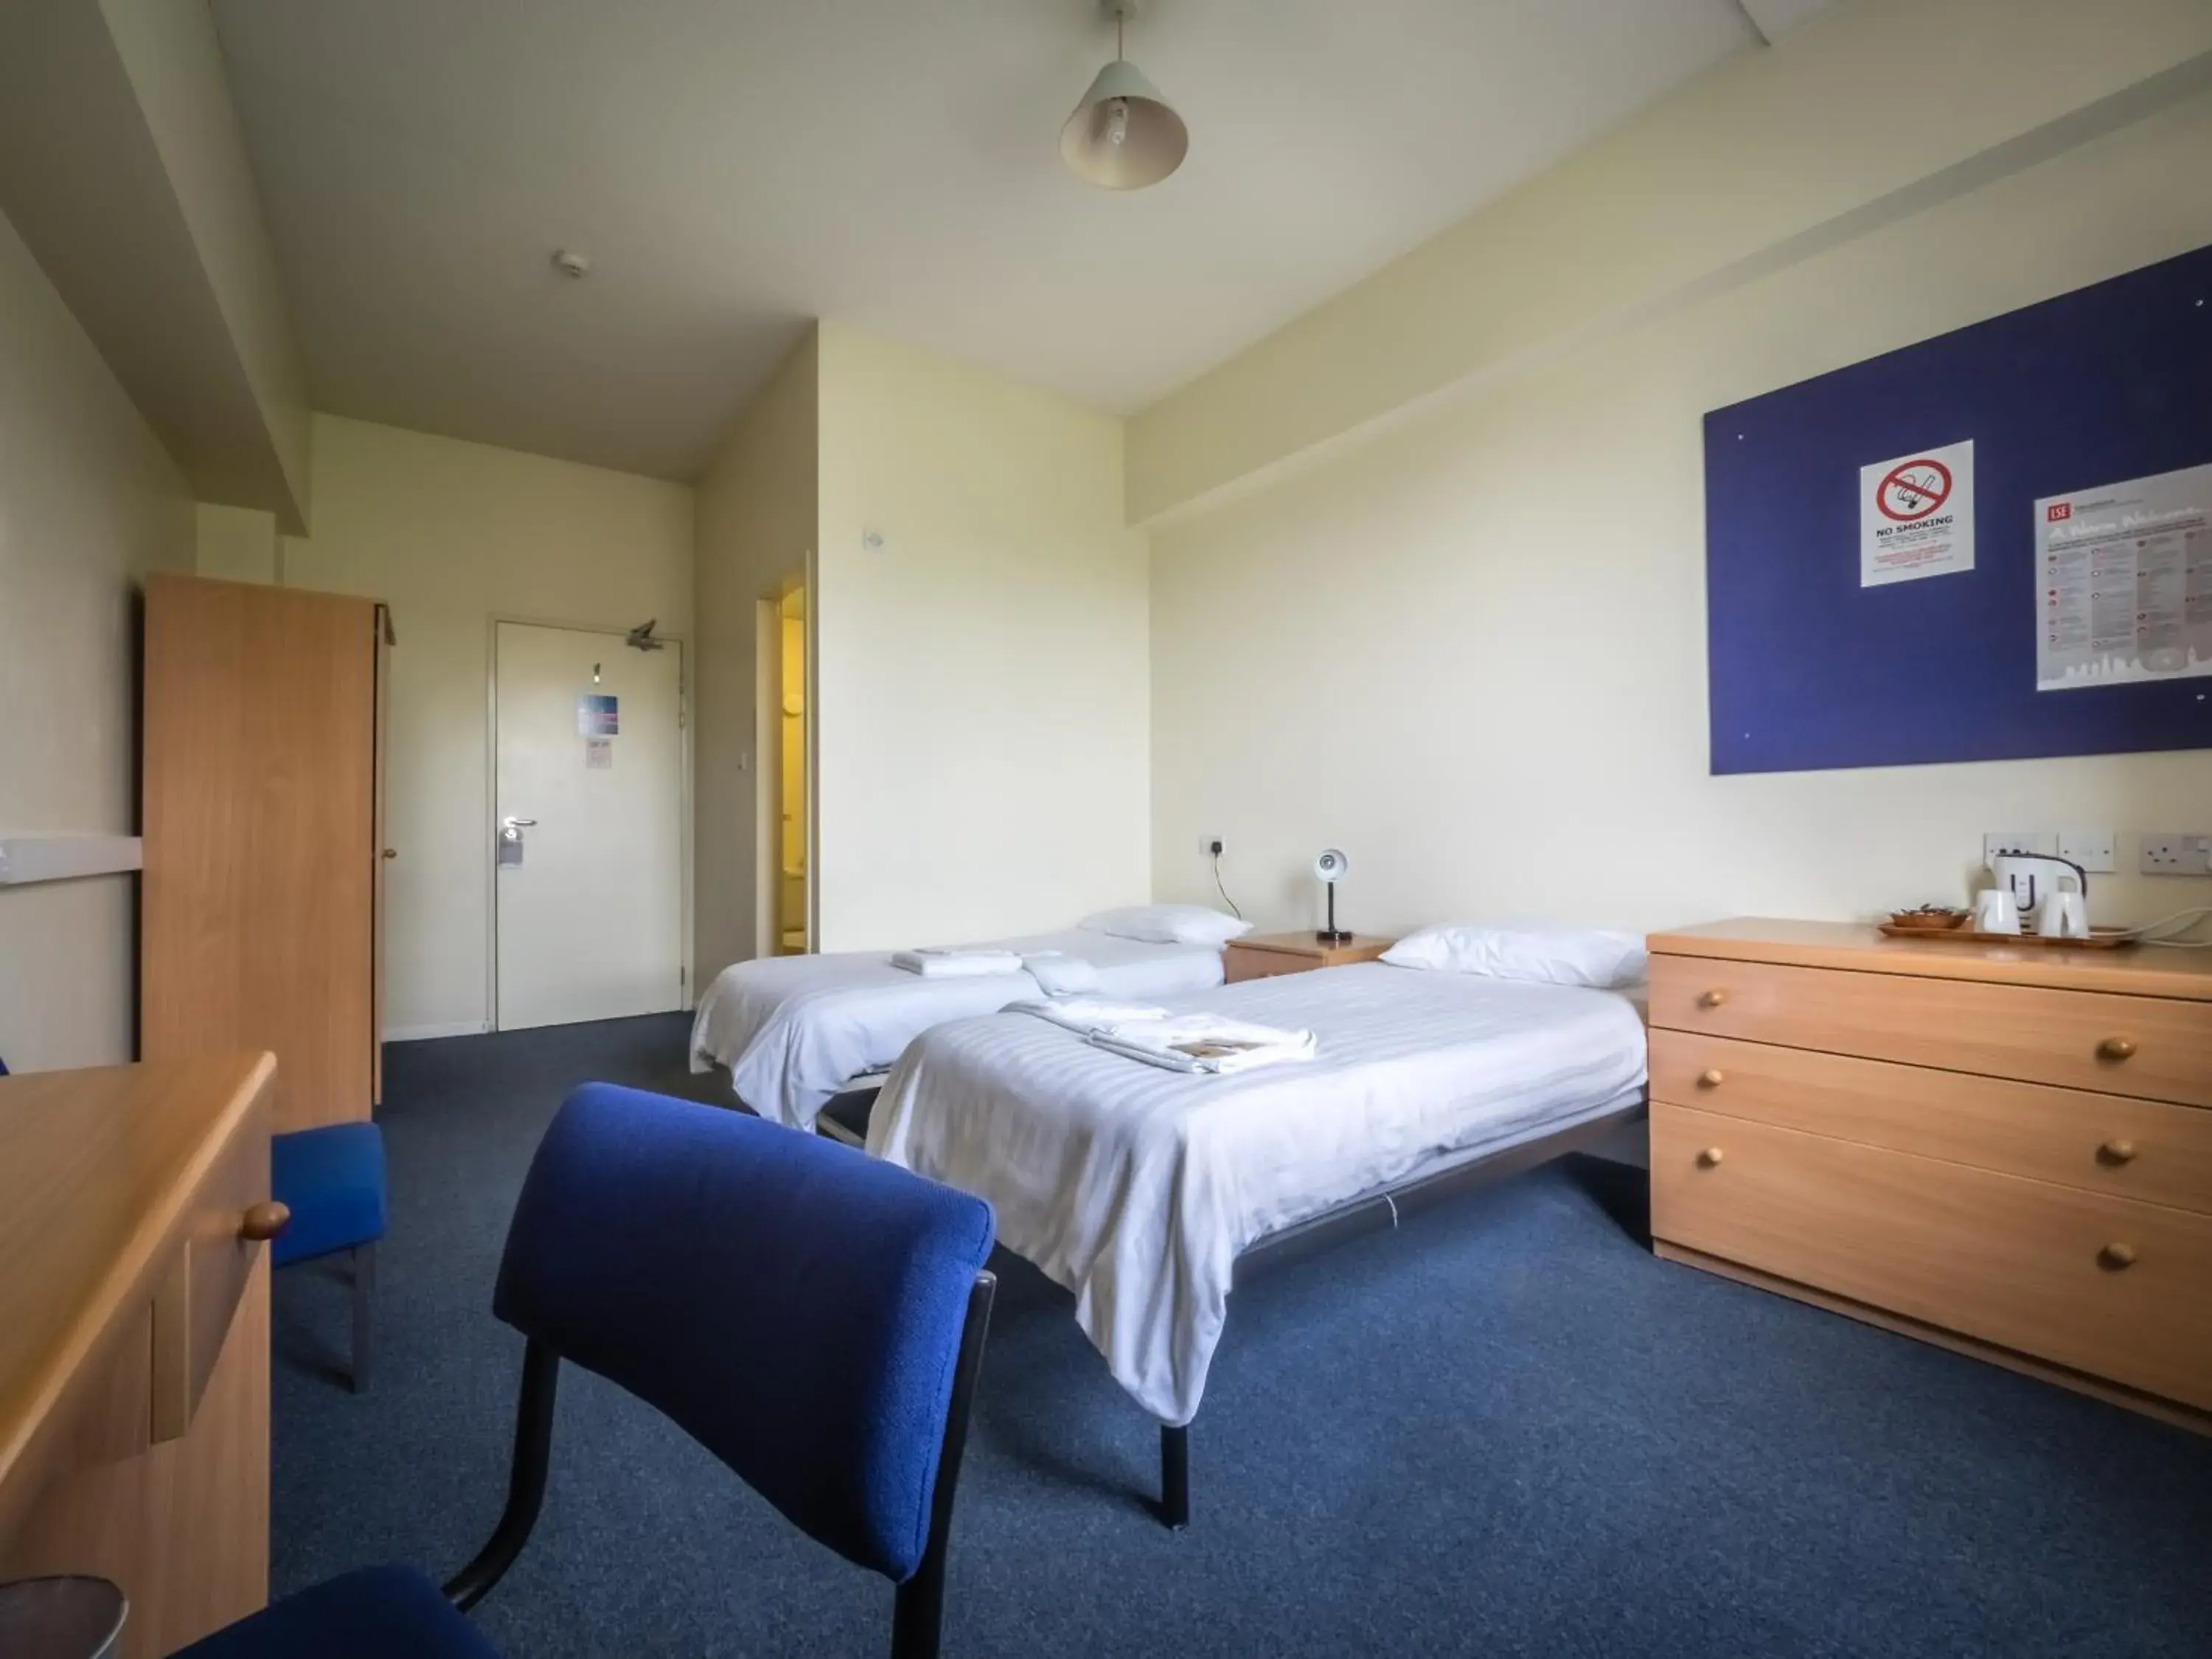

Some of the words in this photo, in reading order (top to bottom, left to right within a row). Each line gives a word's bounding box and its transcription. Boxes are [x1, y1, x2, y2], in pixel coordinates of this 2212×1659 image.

[2050, 504, 2067, 519] LSE
[1877, 527, 1893, 538] NO
[1896, 515, 1953, 533] SMOKING
